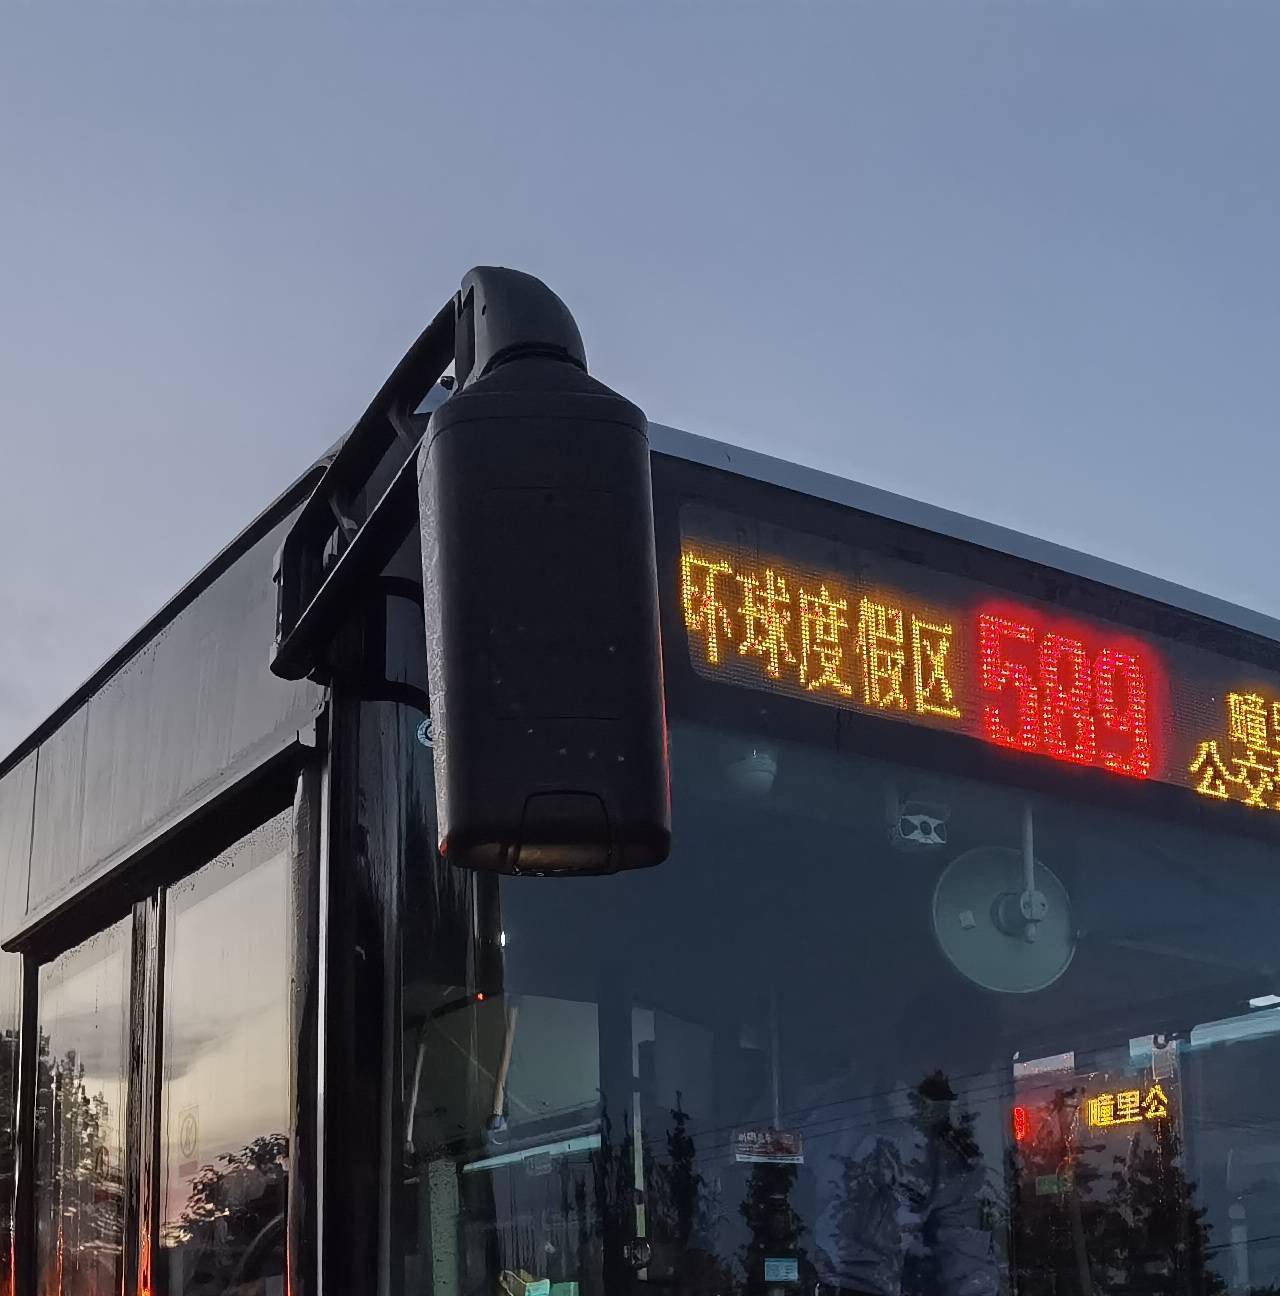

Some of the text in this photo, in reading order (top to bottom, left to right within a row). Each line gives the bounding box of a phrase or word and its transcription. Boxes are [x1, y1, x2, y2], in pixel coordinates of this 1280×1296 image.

[681, 551, 1153, 779] 环球度假区 589
